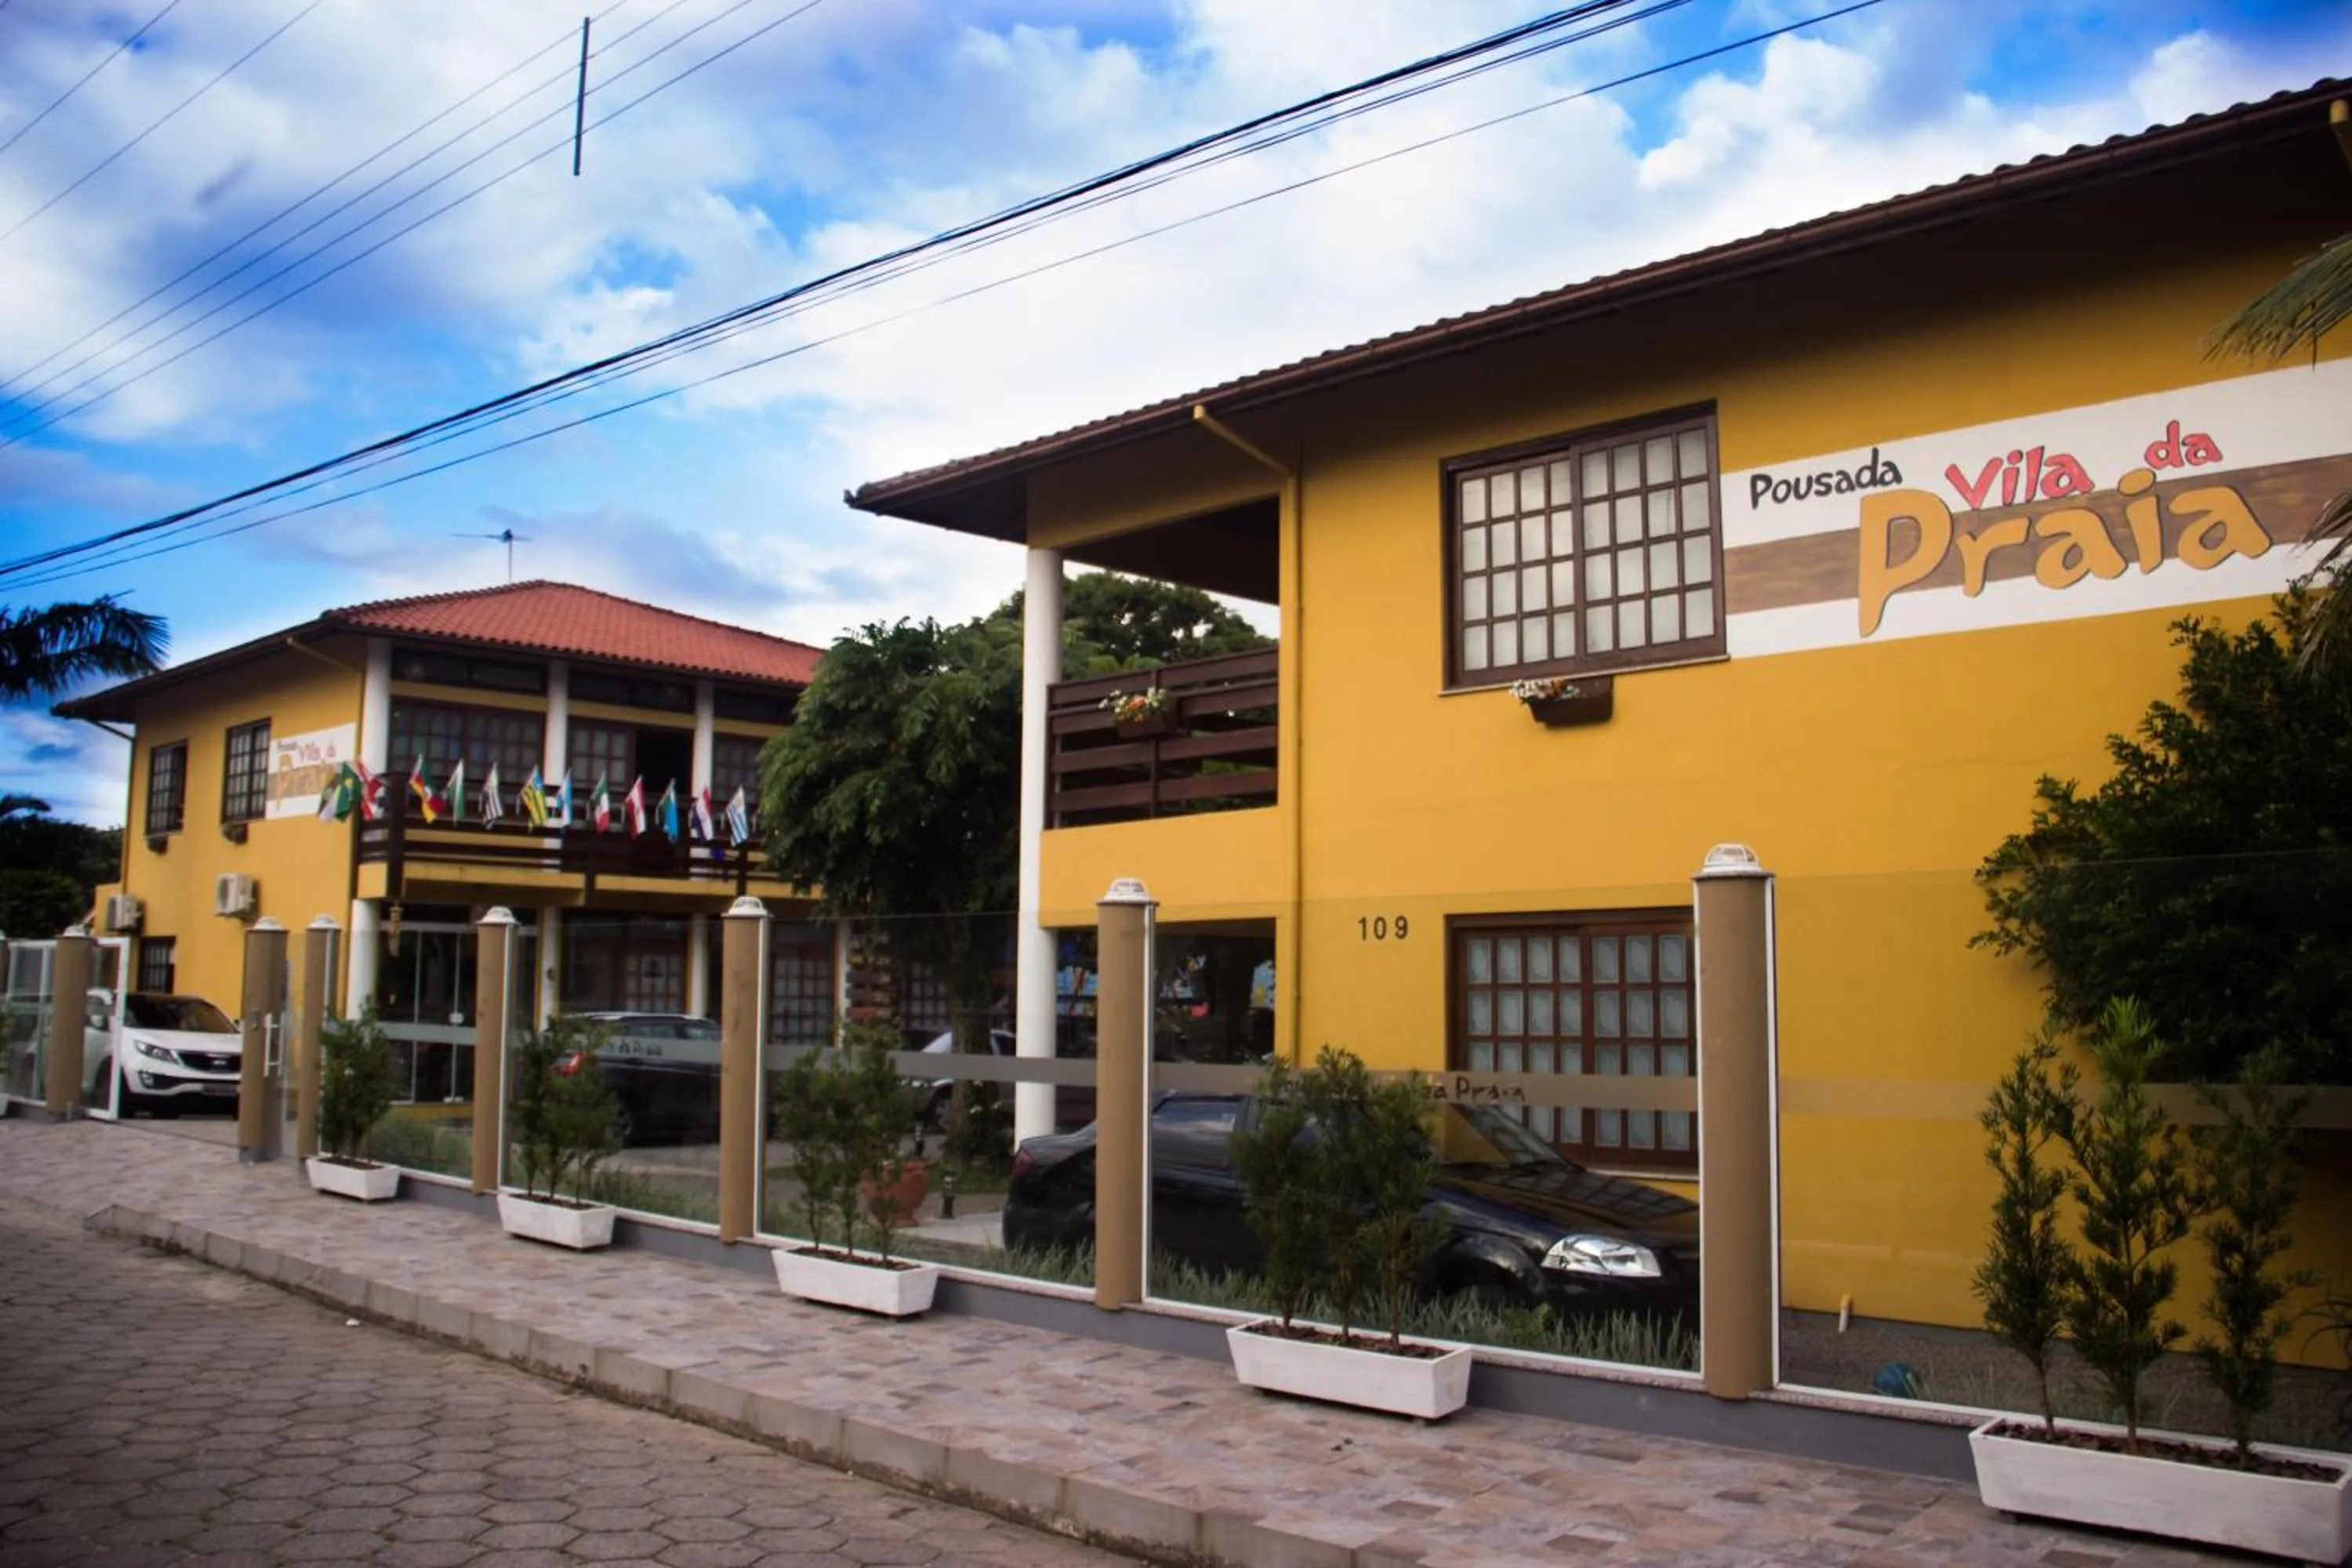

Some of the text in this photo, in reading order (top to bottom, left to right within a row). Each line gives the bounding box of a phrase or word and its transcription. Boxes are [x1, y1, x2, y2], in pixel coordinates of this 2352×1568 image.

[1750, 420, 2223, 510] Pousada Vila da
[1859, 469, 2272, 637] Praia
[1358, 916, 1408, 940] 109
